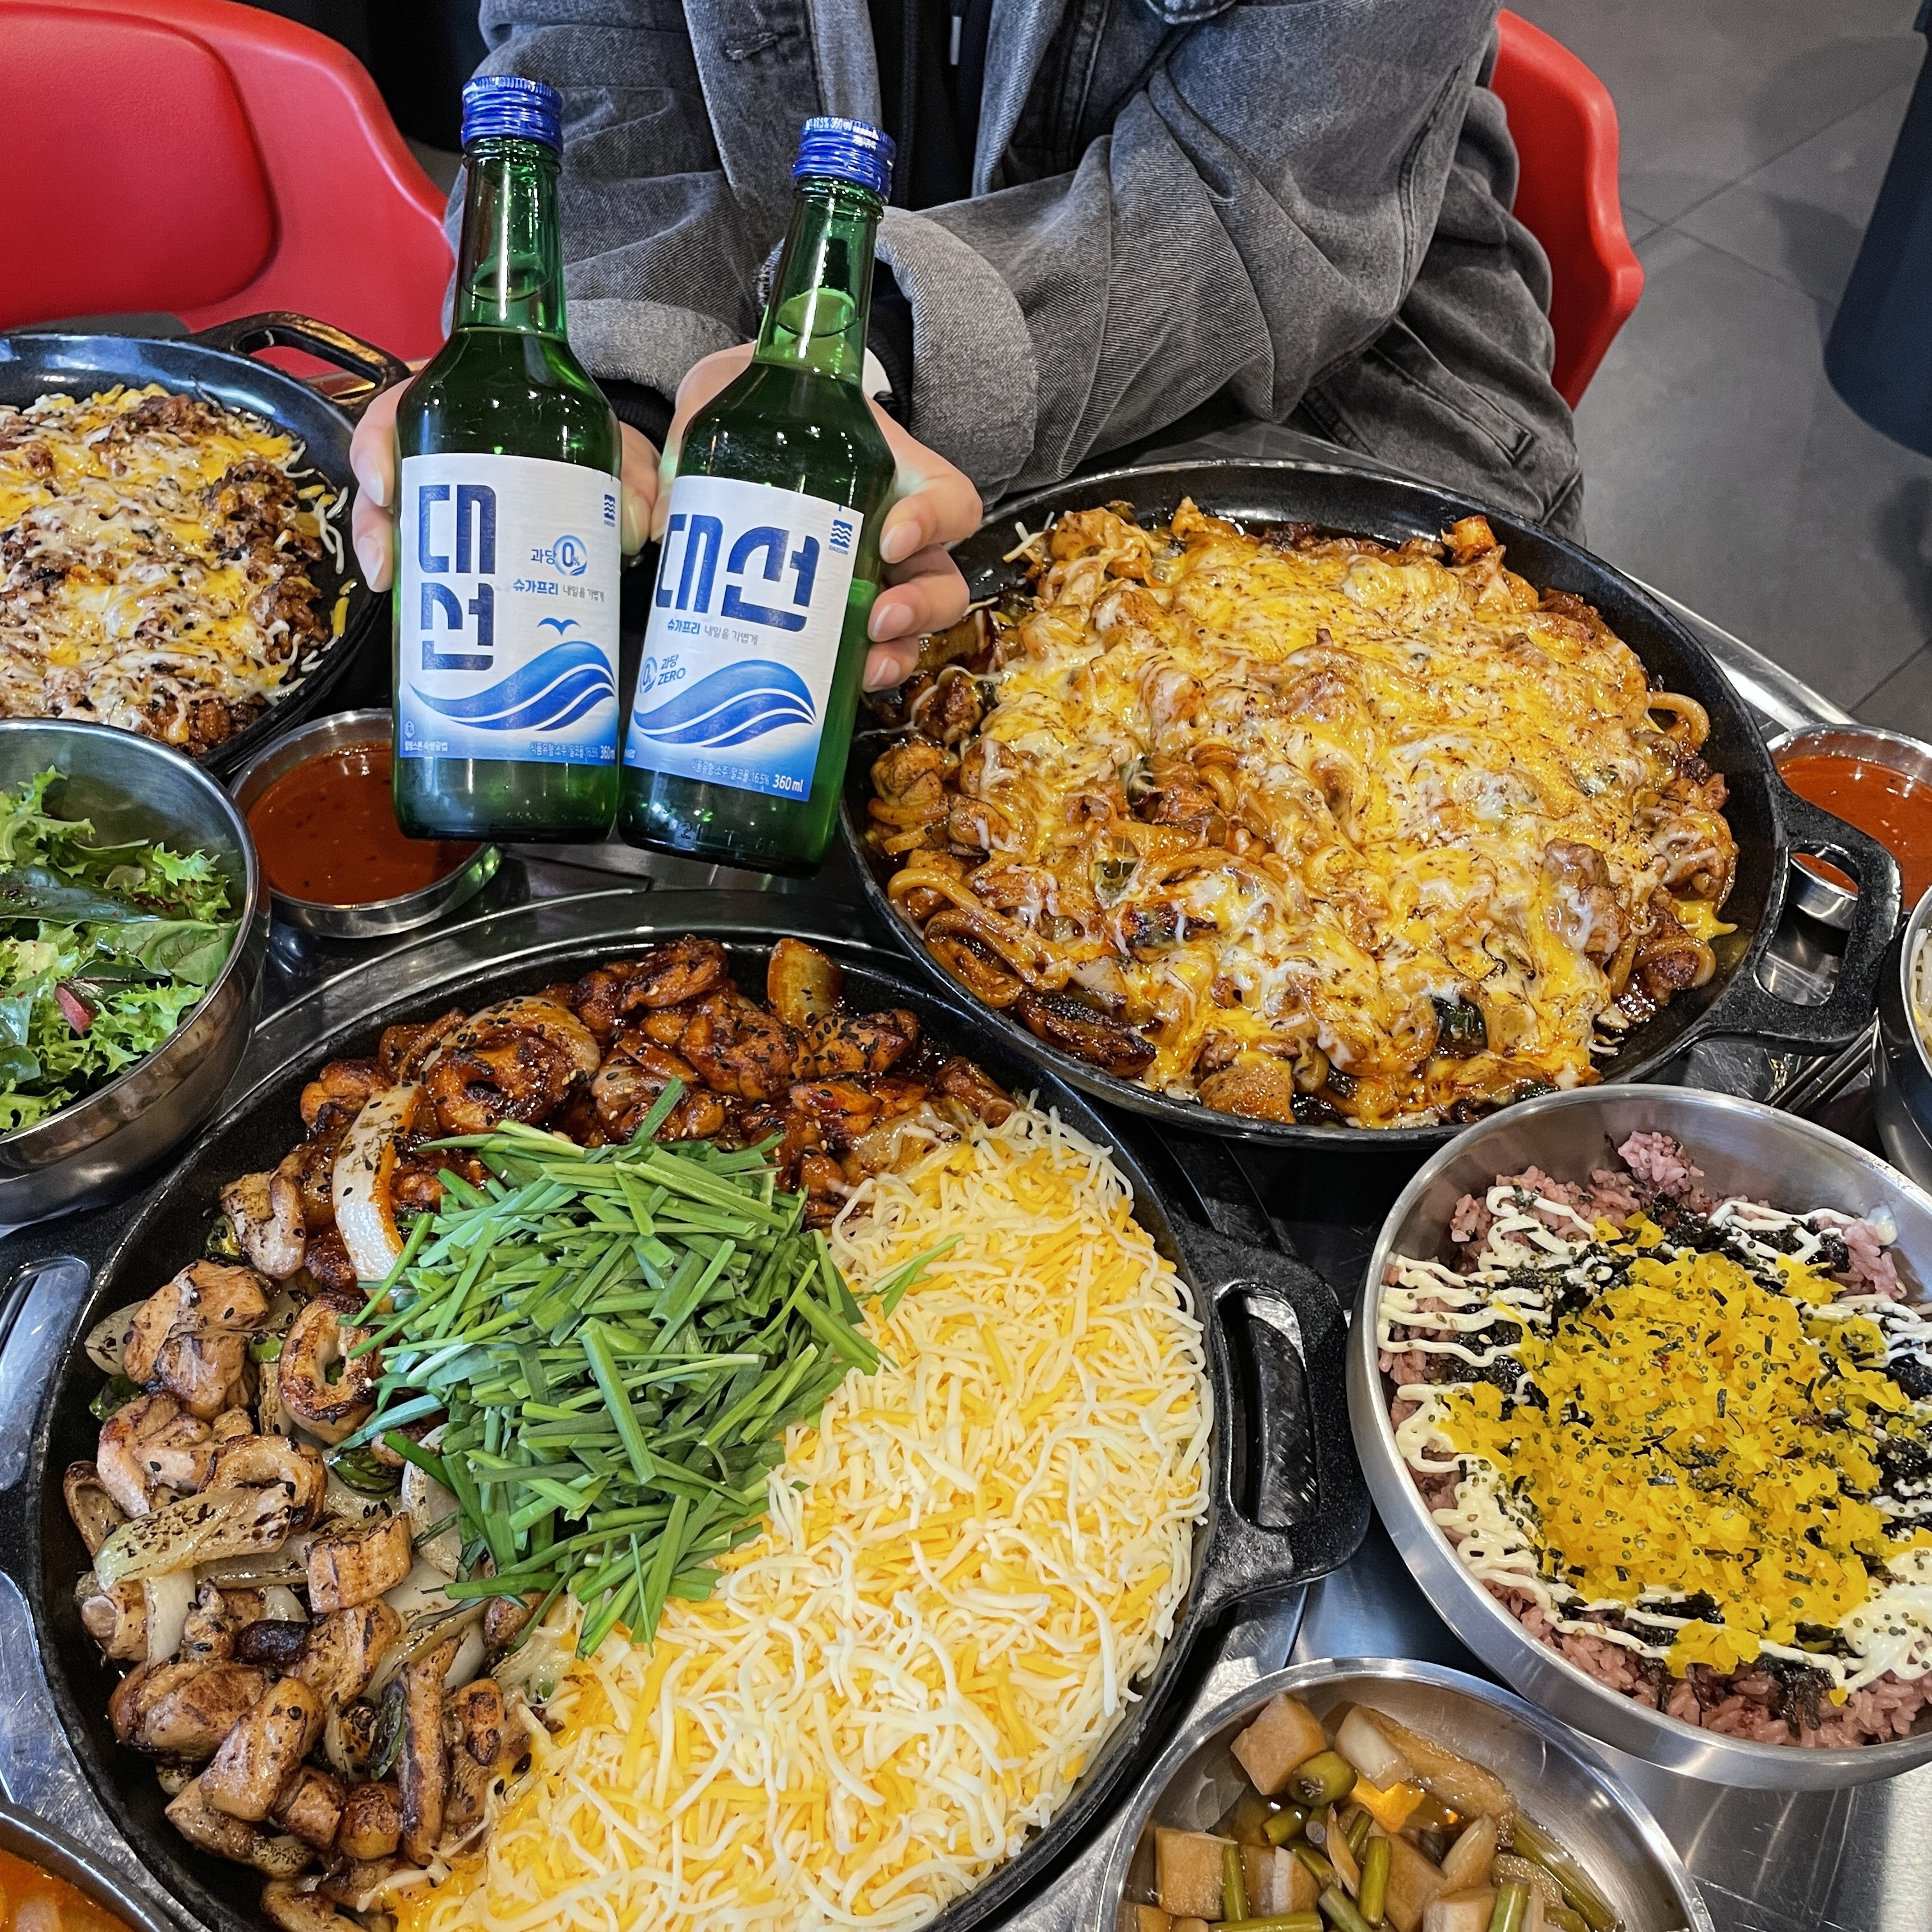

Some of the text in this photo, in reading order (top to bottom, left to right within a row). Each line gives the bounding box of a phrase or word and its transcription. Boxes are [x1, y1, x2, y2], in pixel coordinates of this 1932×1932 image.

[530, 548, 557, 565] 과당
[656, 514, 820, 632] 대선
[513, 578, 558, 595] 슈가프리
[563, 585, 585, 599] 내일을
[667, 618, 758, 646] 슈가프리 내일을 가볍게
[661, 654, 678, 670] 과당
[657, 668, 686, 686] ZERO
[772, 774, 804, 793] 360ml
